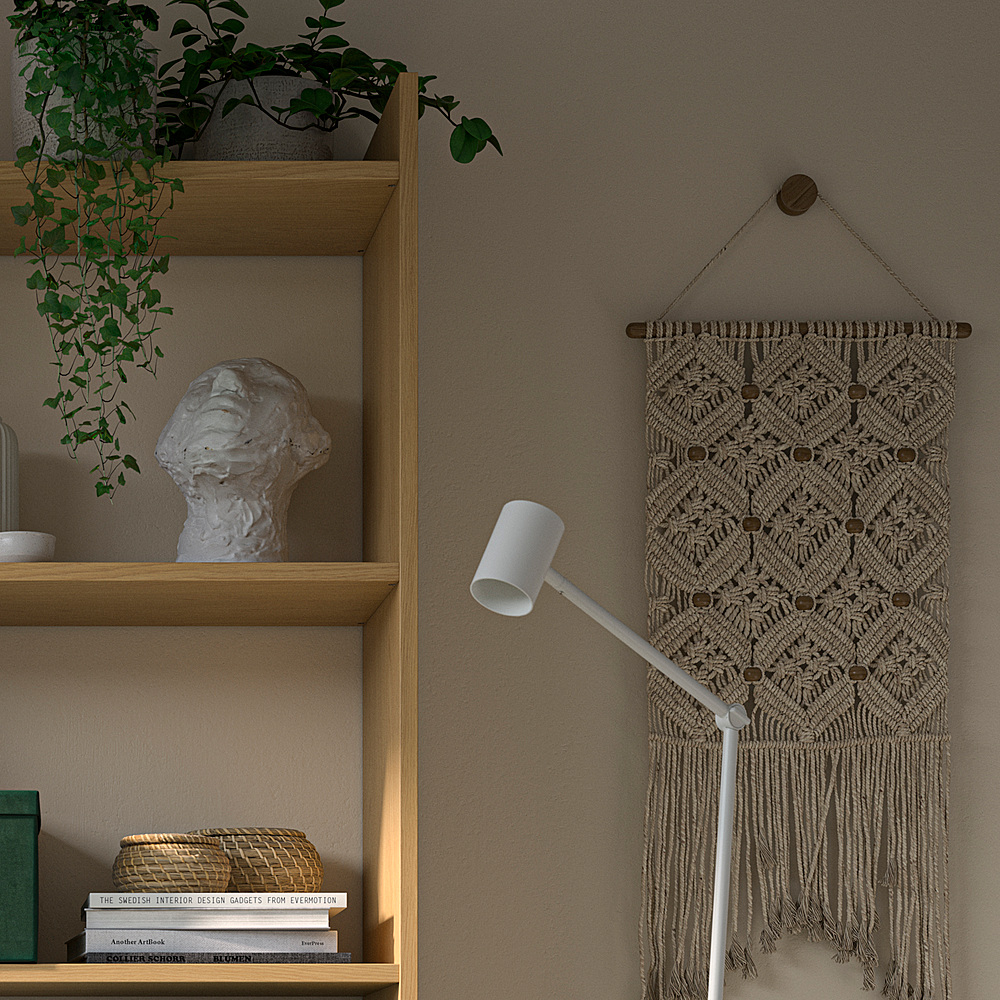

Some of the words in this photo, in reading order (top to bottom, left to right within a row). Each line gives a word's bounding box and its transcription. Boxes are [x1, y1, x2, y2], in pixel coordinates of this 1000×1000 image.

[100, 896, 114, 904] THE
[118, 896, 151, 904] SWEDISH
[156, 896, 193, 904] INTERIOR
[197, 896, 226, 904] DESIGN
[230, 896, 262, 904] GADGETS
[267, 896, 286, 904] FROM
[290, 896, 337, 904] EVERMOTION
[106, 955, 146, 963] COLLIER
[147, 955, 186, 963] SCHORR
[213, 955, 252, 963] BLUMEN
